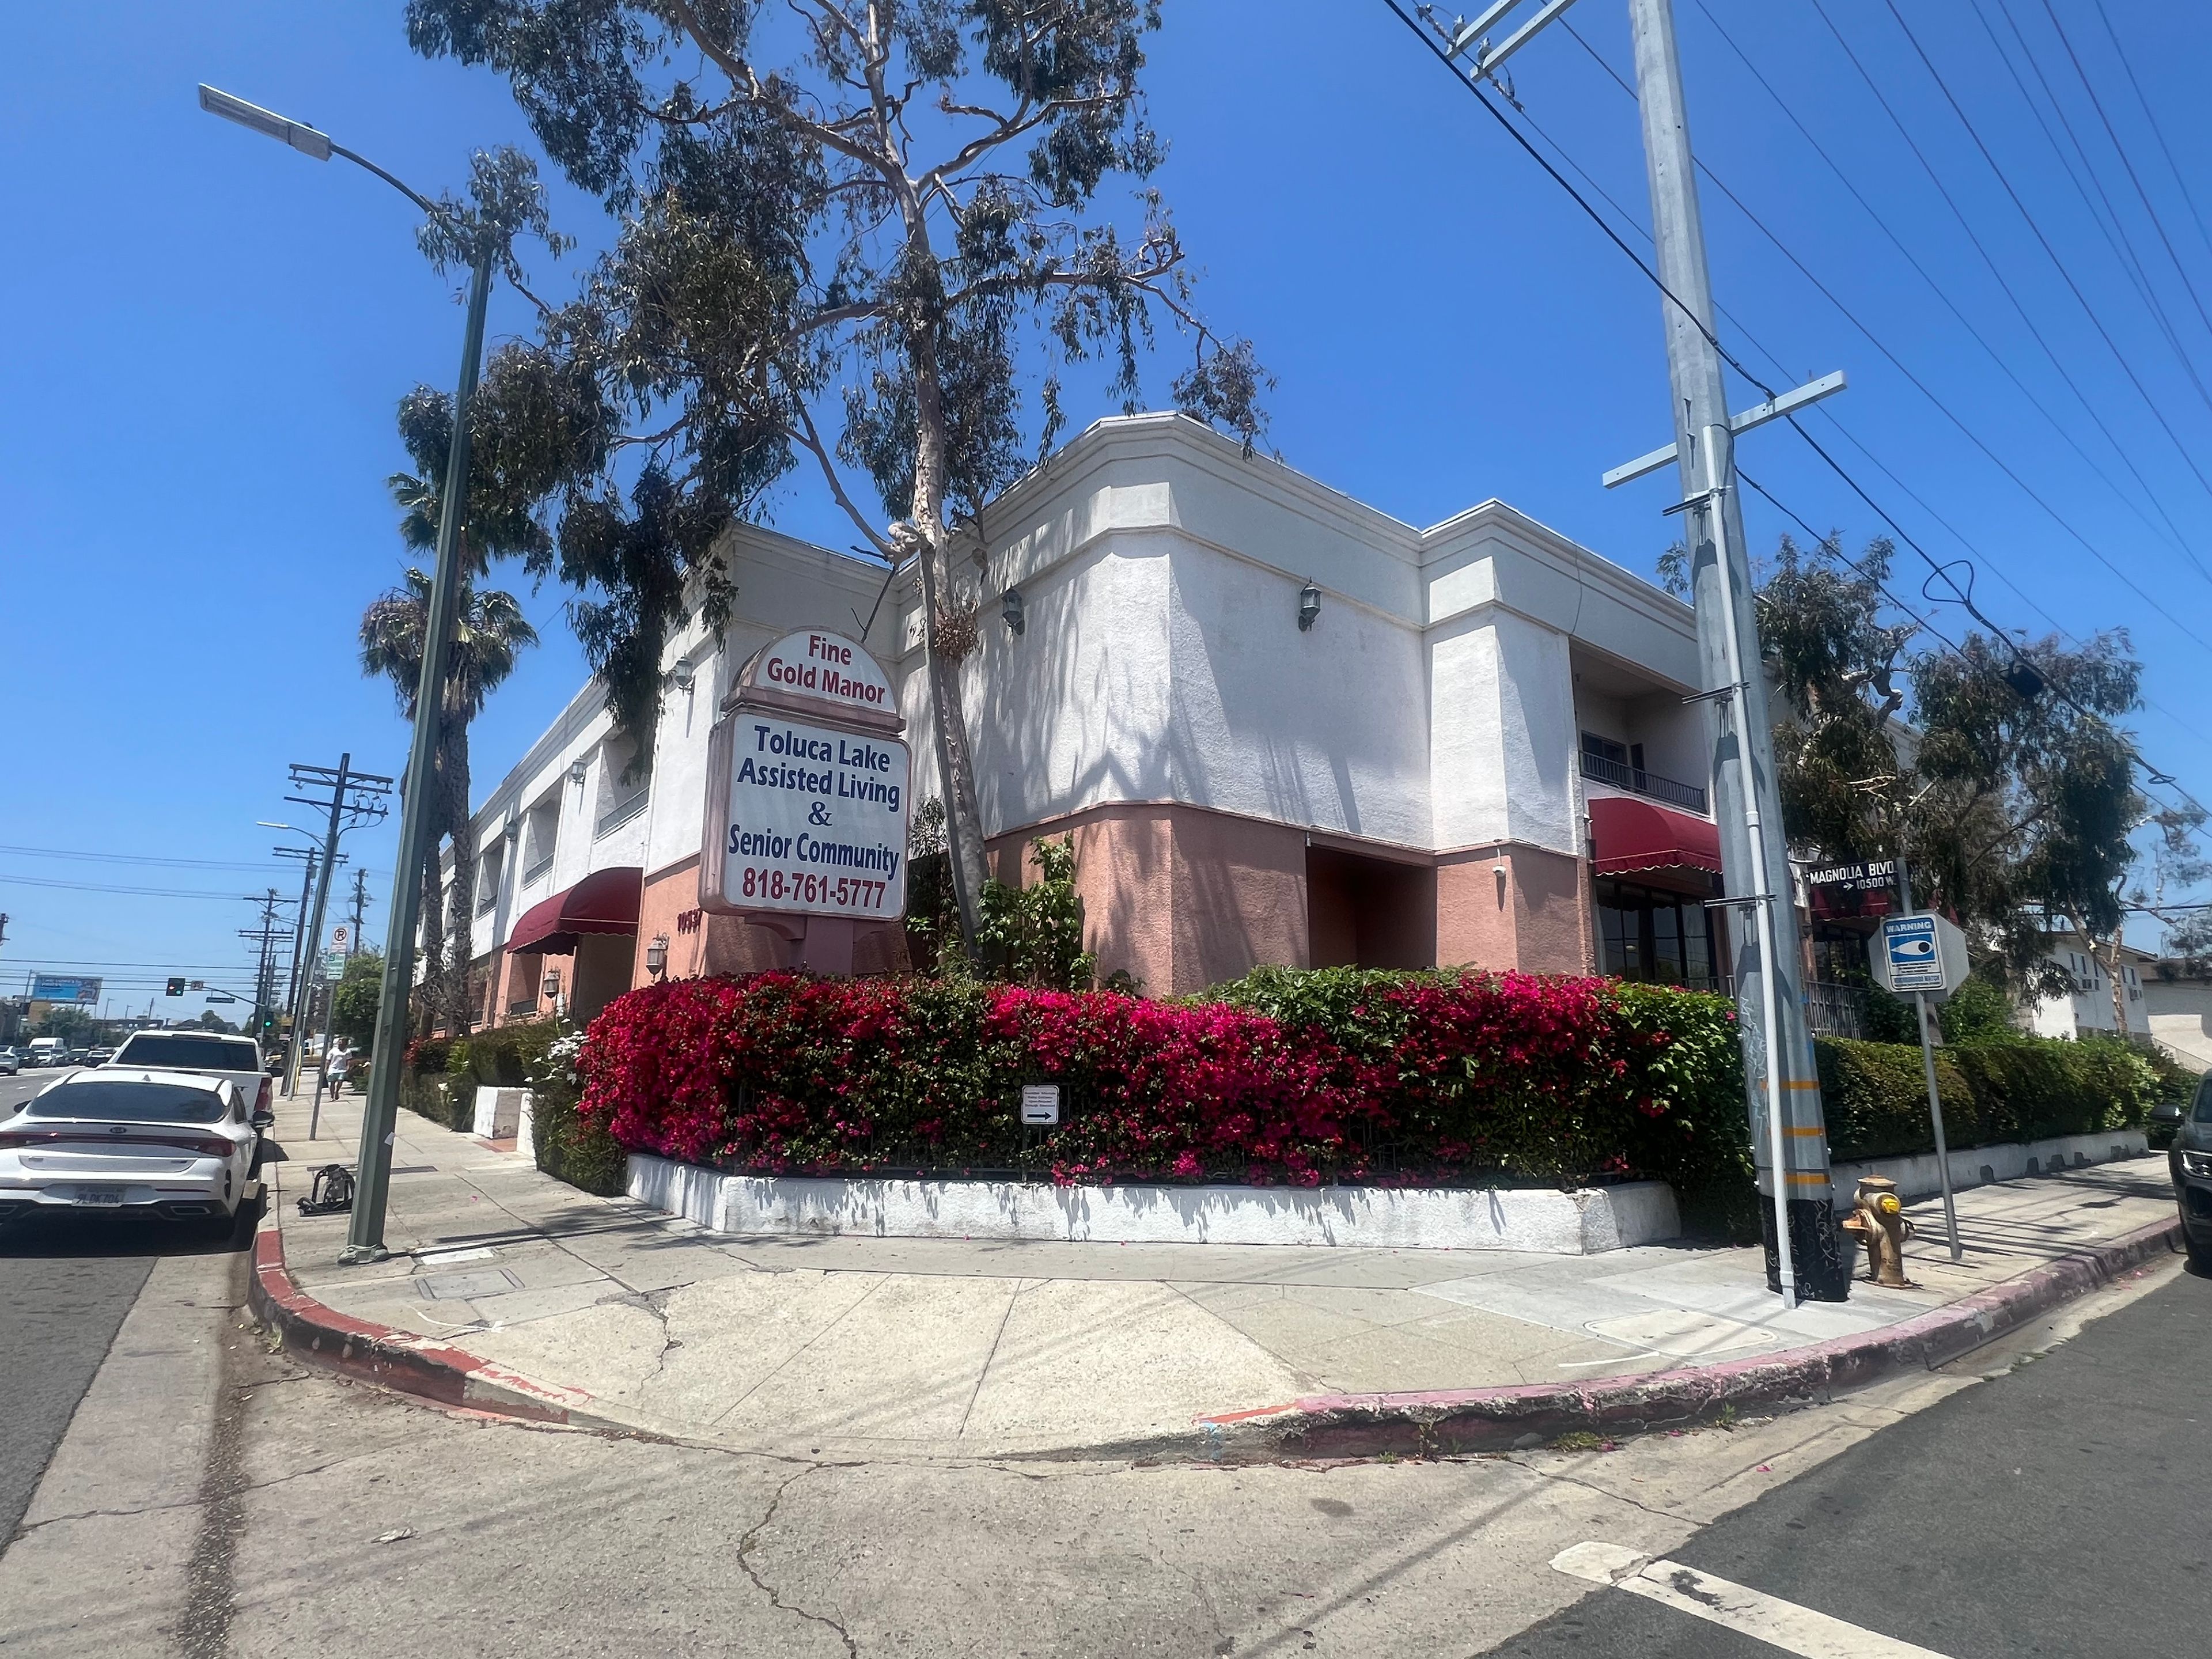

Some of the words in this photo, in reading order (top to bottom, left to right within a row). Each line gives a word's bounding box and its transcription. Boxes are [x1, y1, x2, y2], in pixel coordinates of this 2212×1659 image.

[809, 634, 851, 665] Fine
[767, 657, 817, 690] Gold
[821, 669, 885, 704] Manor
[754, 725, 832, 762] Toluca
[838, 740, 891, 772] Lake
[737, 757, 833, 795] Assisted
[838, 771, 900, 813] Living
[808, 801, 833, 827] &
[728, 824, 792, 859] Senior
[797, 832, 900, 881] Community
[743, 867, 885, 908] 818-761-5777
[1809, 865, 1863, 885] MAGNOLIA
[1855, 877, 1884, 890] 10500
[1886, 921, 1932, 933] WARNING
